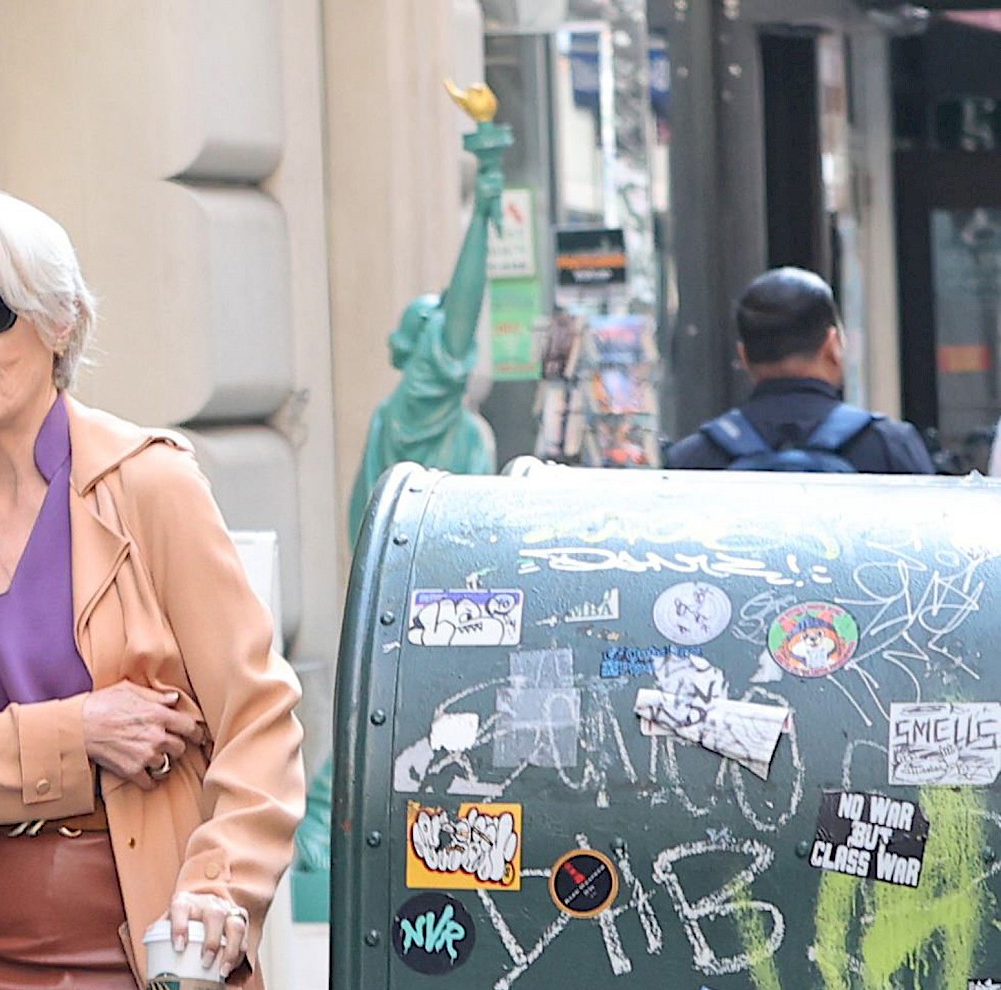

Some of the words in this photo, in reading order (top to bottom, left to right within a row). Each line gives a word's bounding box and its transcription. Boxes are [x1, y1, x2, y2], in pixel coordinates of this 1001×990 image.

[838, 792, 865, 821] NO
[870, 795, 915, 831] WAR
[847, 820, 893, 851] BUT
[810, 840, 872, 877] CLASS
[877, 841, 921, 887] WAR
